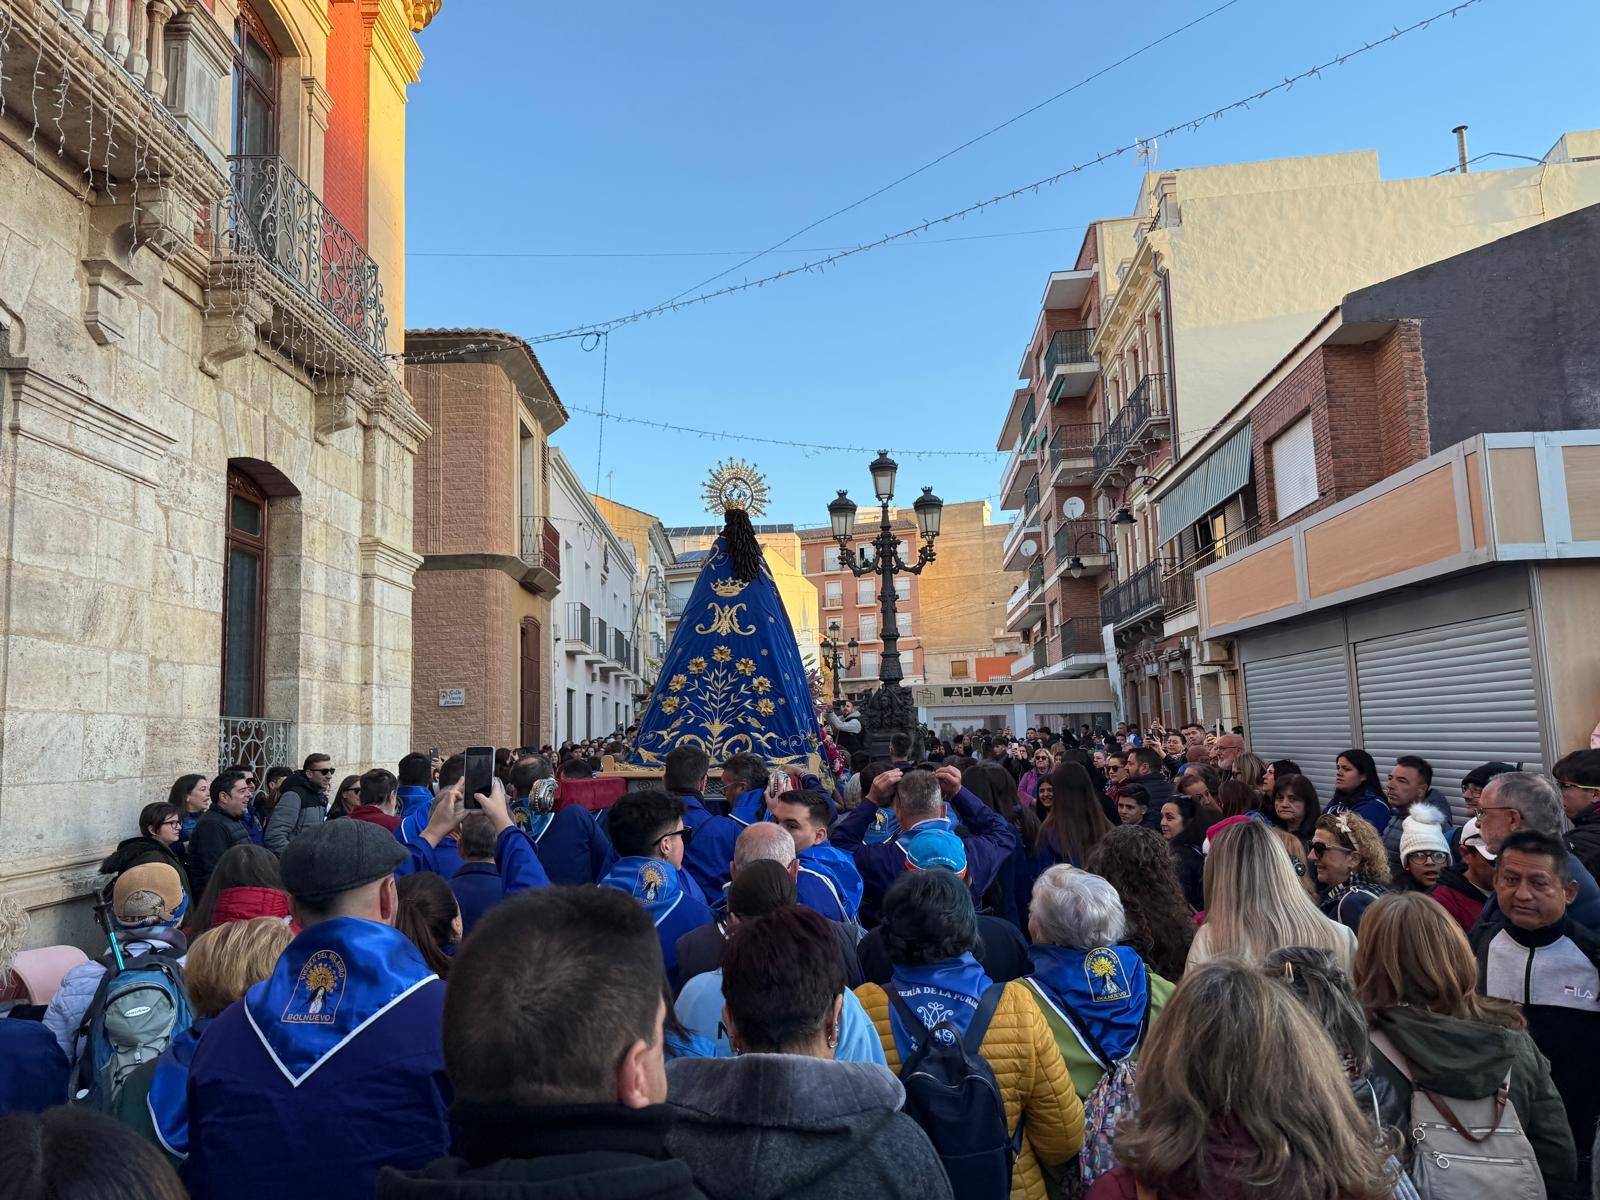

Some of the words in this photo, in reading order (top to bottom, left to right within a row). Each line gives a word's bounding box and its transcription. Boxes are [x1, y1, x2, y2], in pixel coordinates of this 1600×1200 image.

[317, 952, 328, 960] DEL
[923, 986, 937, 995] DE
[939, 990, 952, 998] LA
[1564, 985, 1593, 999] FILA
[287, 1013, 331, 1021] BOLNUEVO
